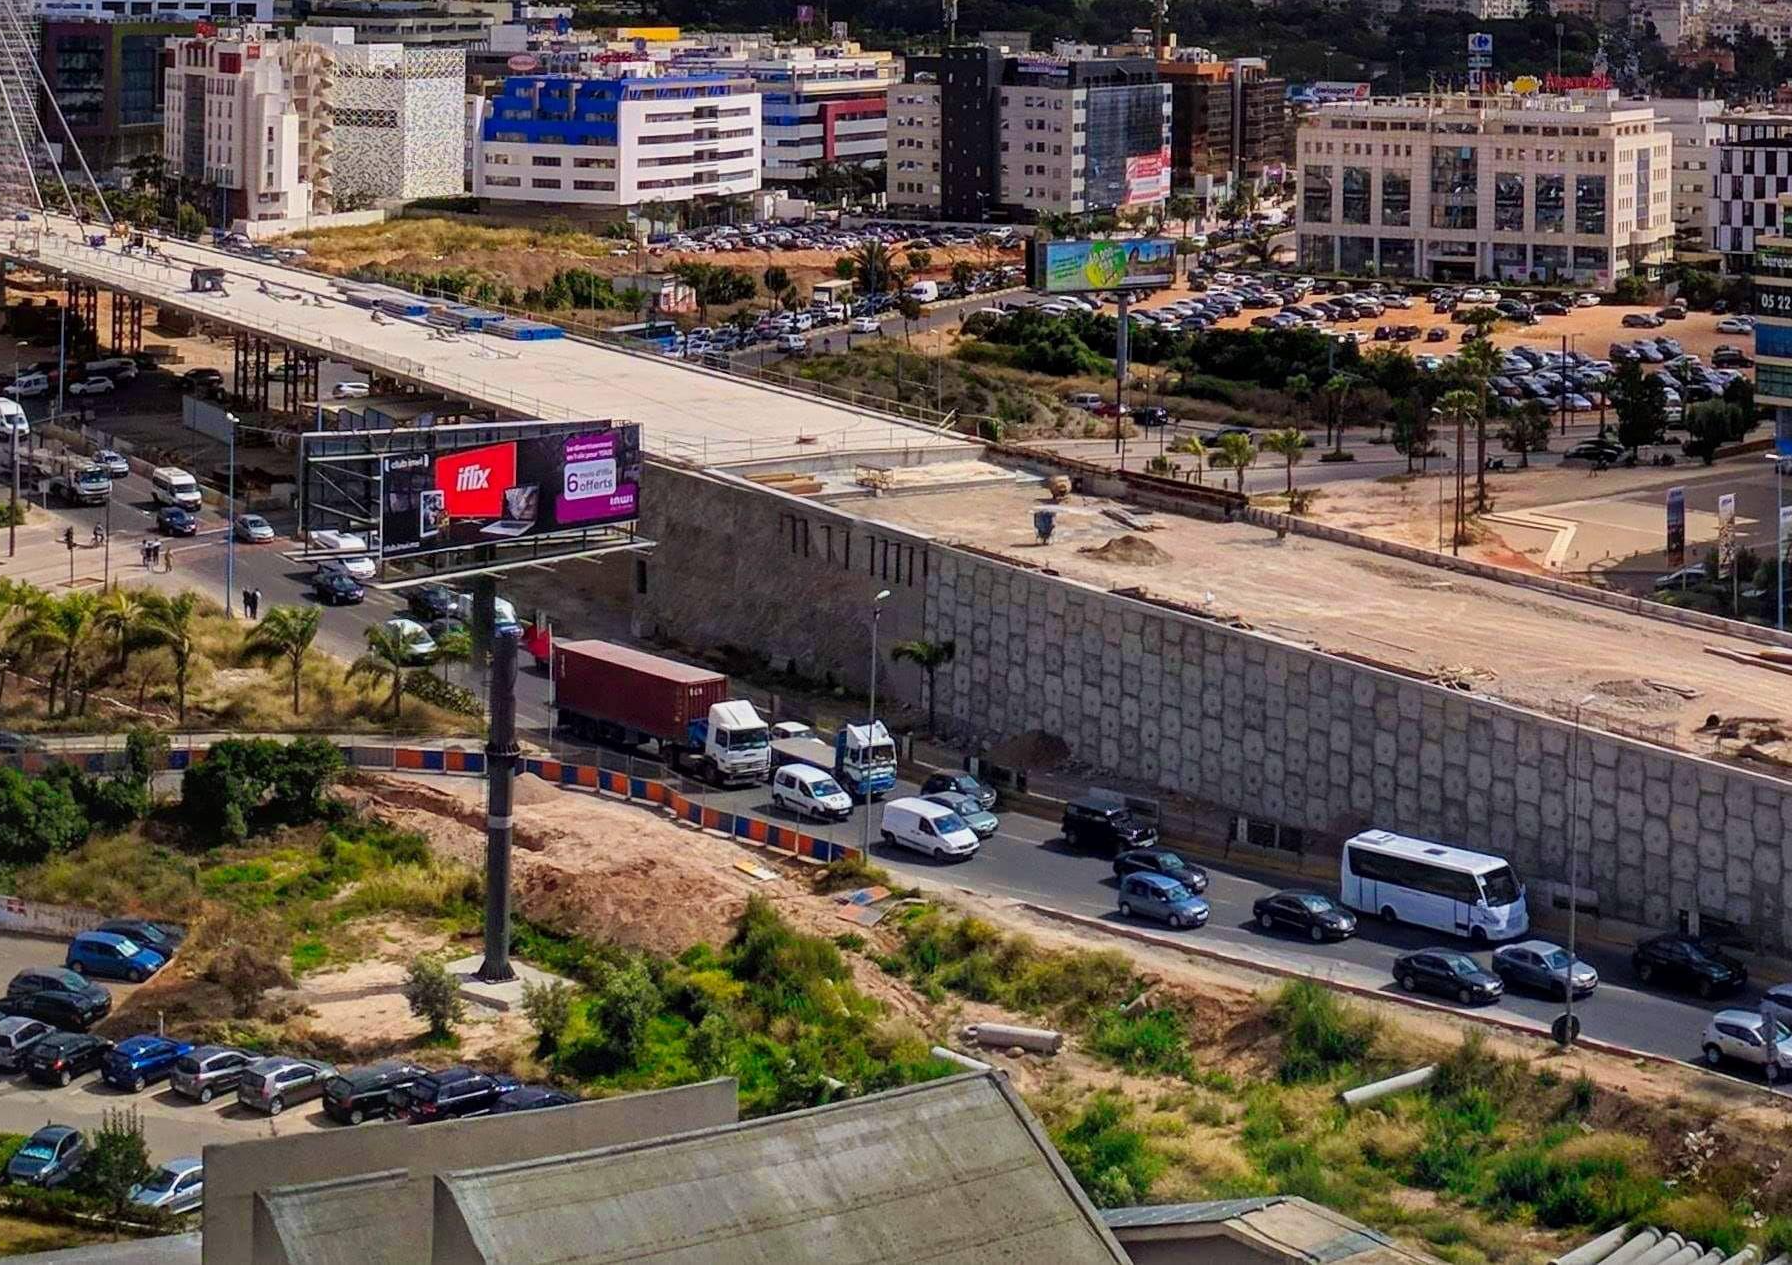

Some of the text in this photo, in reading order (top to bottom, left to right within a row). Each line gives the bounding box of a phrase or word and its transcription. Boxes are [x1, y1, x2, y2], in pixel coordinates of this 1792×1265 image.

[1761, 293, 1775, 308] 05
[1777, 295, 1791, 310] 22
[456, 464, 491, 492] iflix
[568, 472, 578, 493] 6
[580, 478, 613, 491] offerts
[610, 494, 633, 506] inwi
